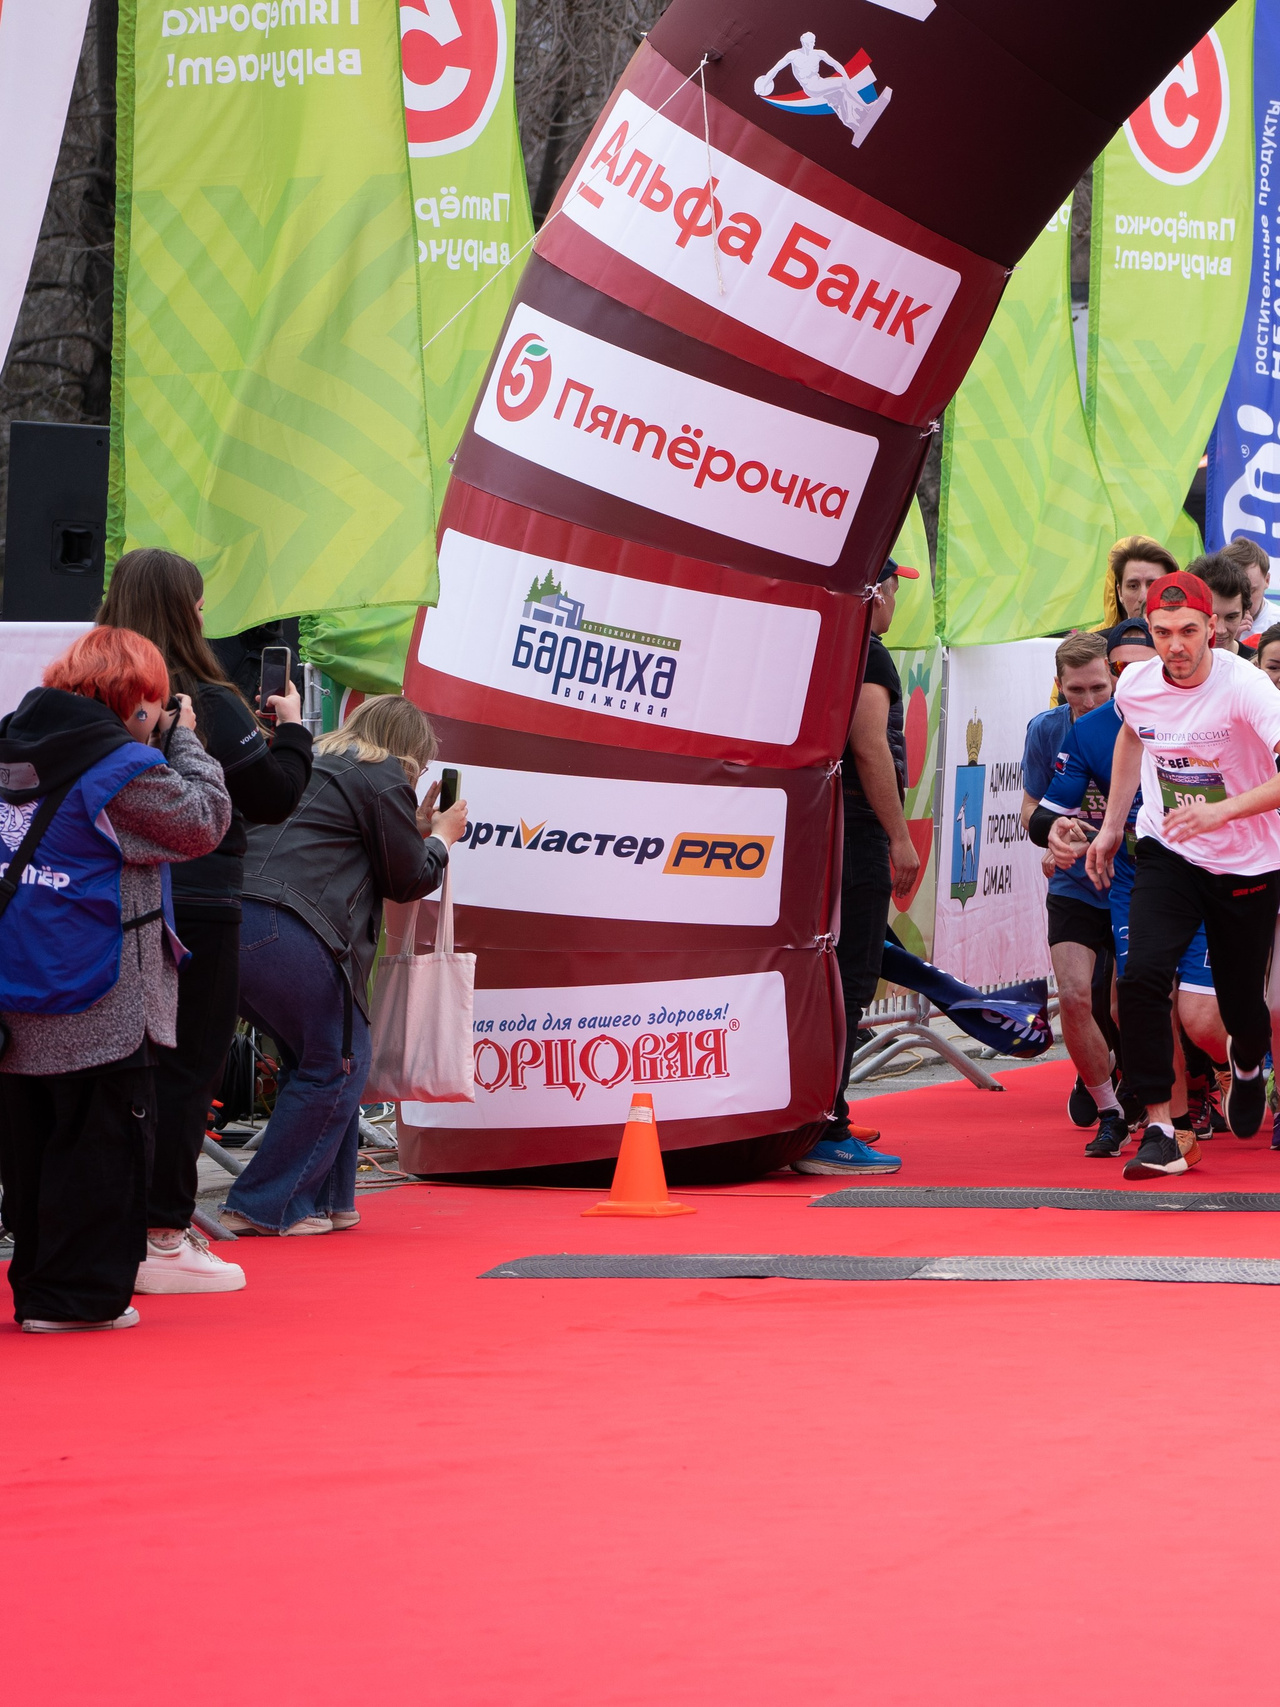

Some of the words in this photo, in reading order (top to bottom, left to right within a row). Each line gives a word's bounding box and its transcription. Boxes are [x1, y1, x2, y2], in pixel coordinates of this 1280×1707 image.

[588, 118, 763, 265] Альфа
[767, 221, 933, 346] Банк
[1255, 215, 1273, 376] растительные
[553, 376, 851, 521] Пятёрочка
[1187, 729, 1231, 742] РОССИИ
[671, 838, 766, 872] PRO
[498, 1012, 538, 1033] вода
[541, 1011, 573, 1032] для
[576, 1013, 642, 1031] вашего
[646, 1002, 730, 1027] здоровья!
